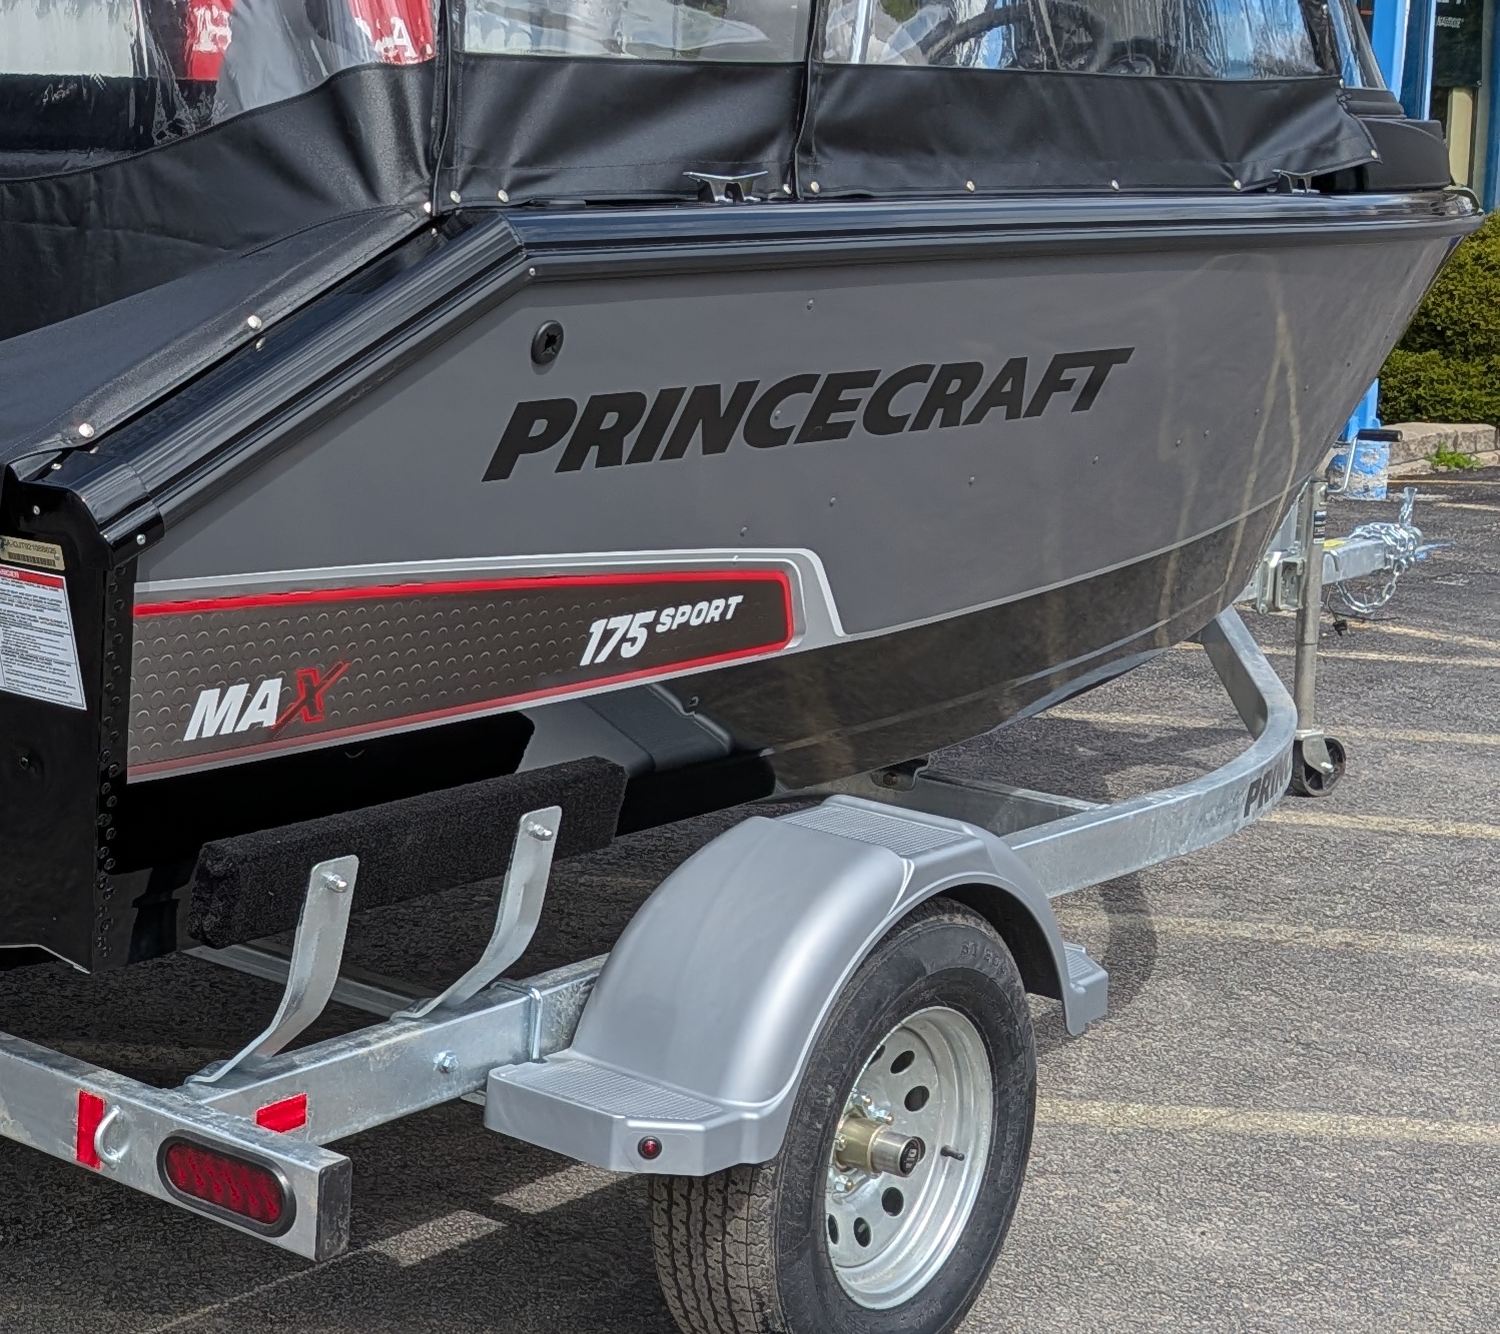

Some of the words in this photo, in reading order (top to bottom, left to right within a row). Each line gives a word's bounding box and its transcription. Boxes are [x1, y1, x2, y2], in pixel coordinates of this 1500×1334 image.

[481, 346, 1136, 483] PRINCECRAFT
[579, 610, 657, 667] 175
[655, 594, 744, 634] SPORT
[183, 661, 351, 742] MAX
